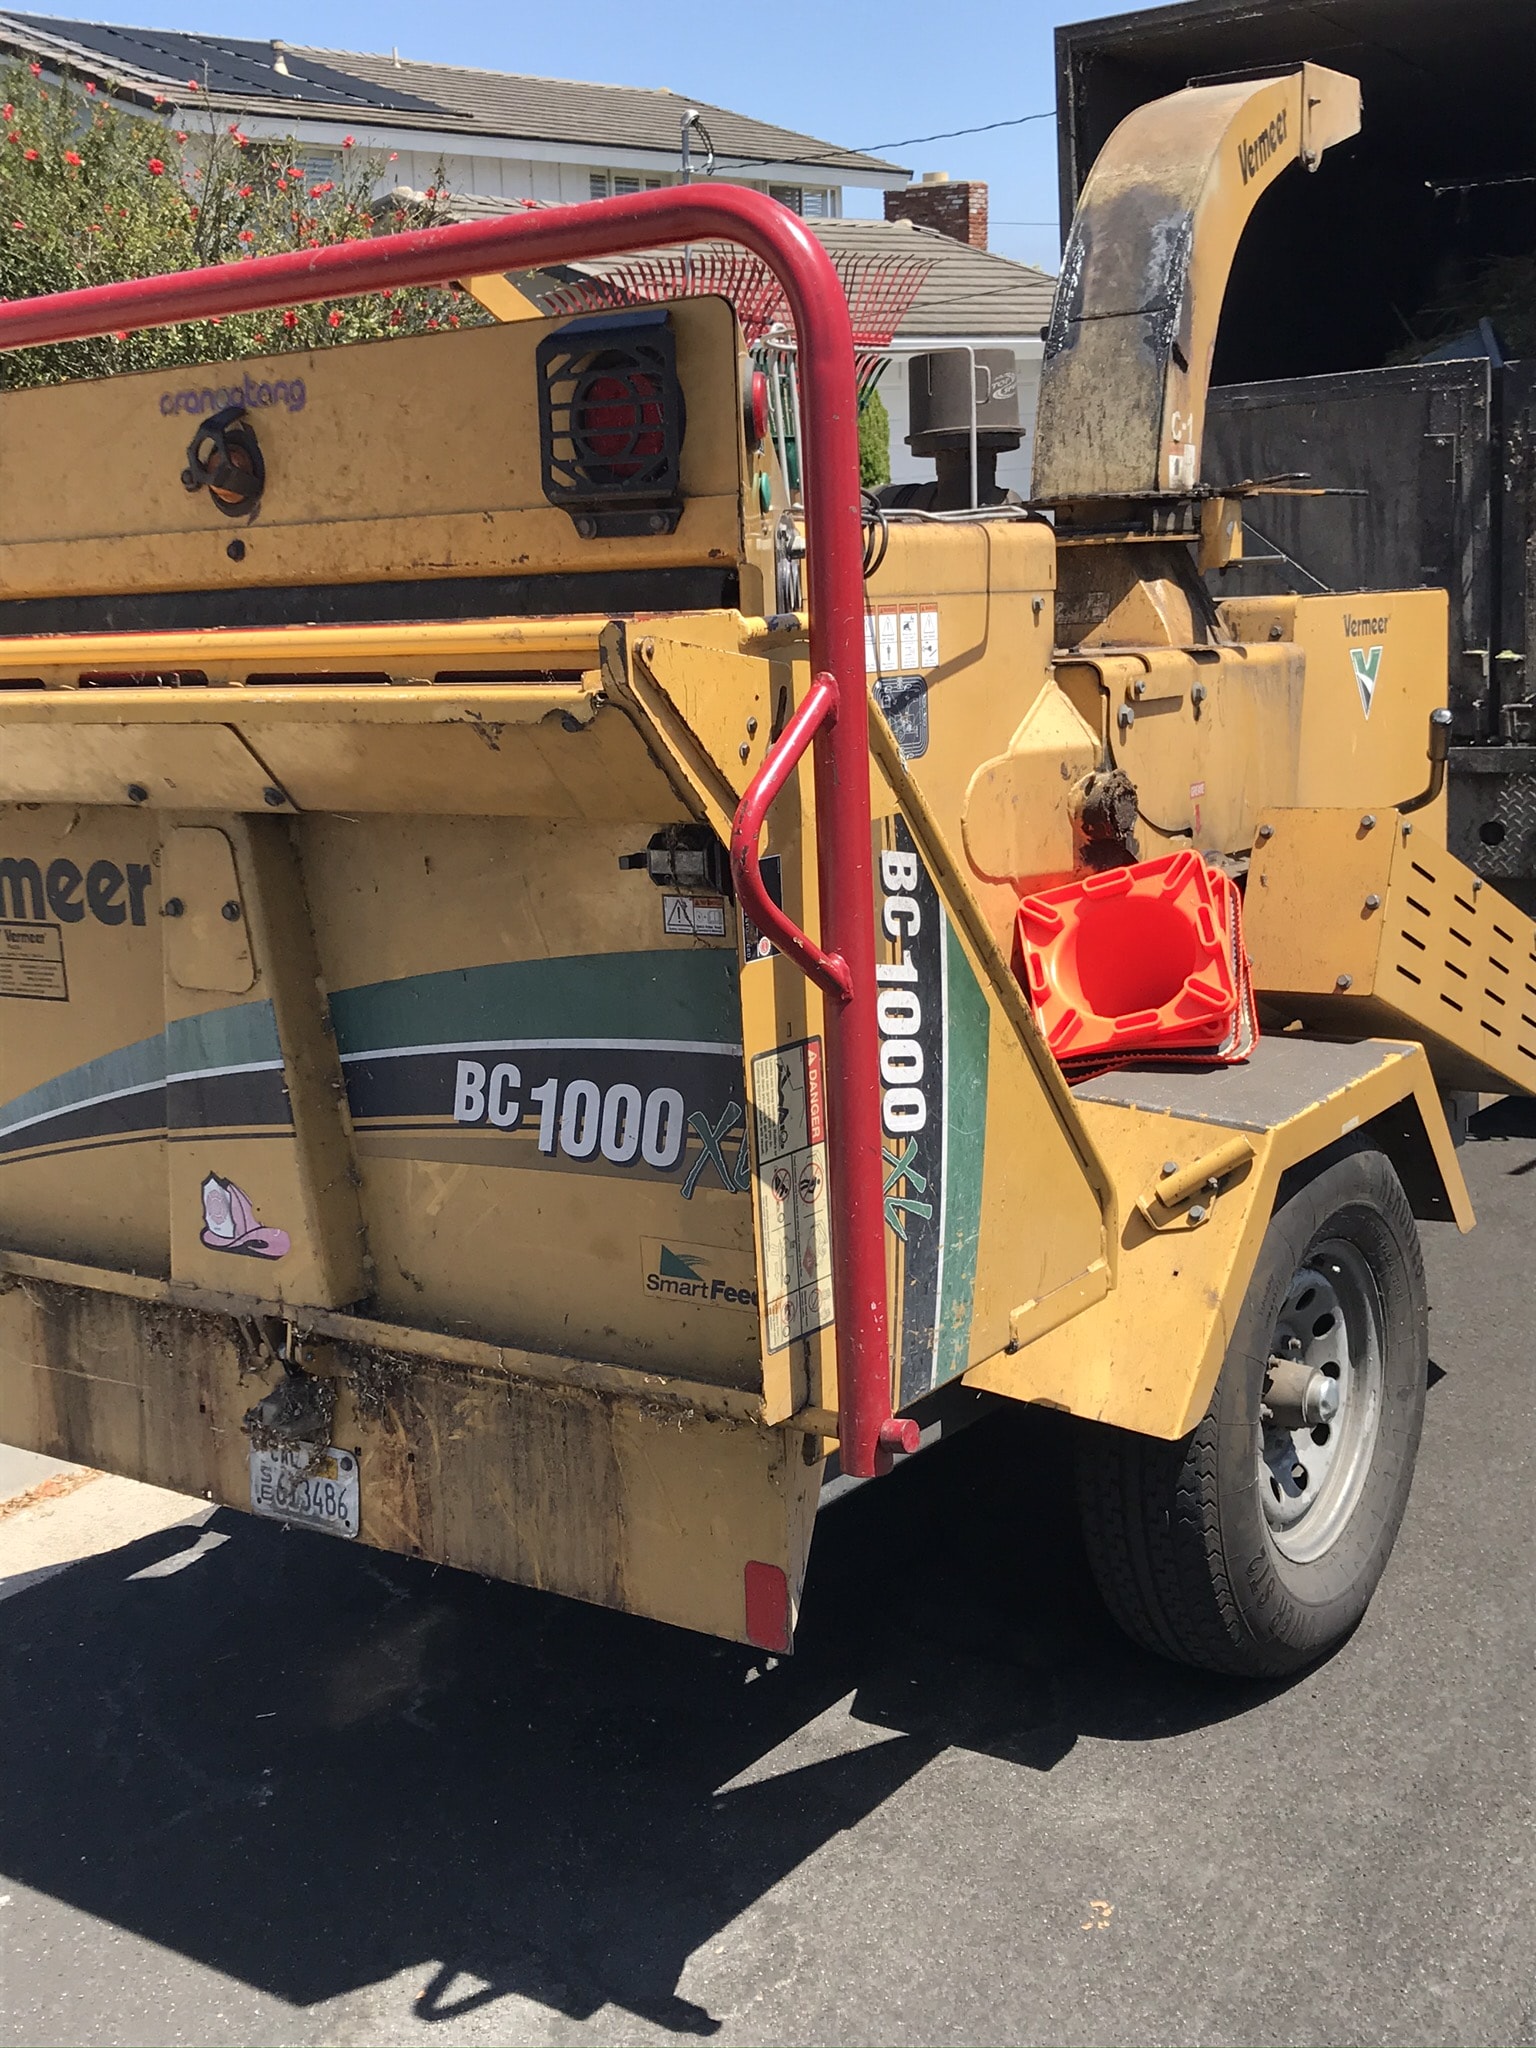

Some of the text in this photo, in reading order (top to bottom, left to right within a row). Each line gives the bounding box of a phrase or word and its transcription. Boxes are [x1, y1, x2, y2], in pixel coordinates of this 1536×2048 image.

[1237, 108, 1287, 186] Vermeer
[1343, 613, 1389, 637] Vermeer
[0, 857, 152, 926] meer
[881, 849, 922, 938] BC
[875, 949, 927, 1133] 1000
[453, 1060, 522, 1129] BC
[530, 1078, 686, 1168] 1000
[808, 1071, 822, 1138] DANGER
